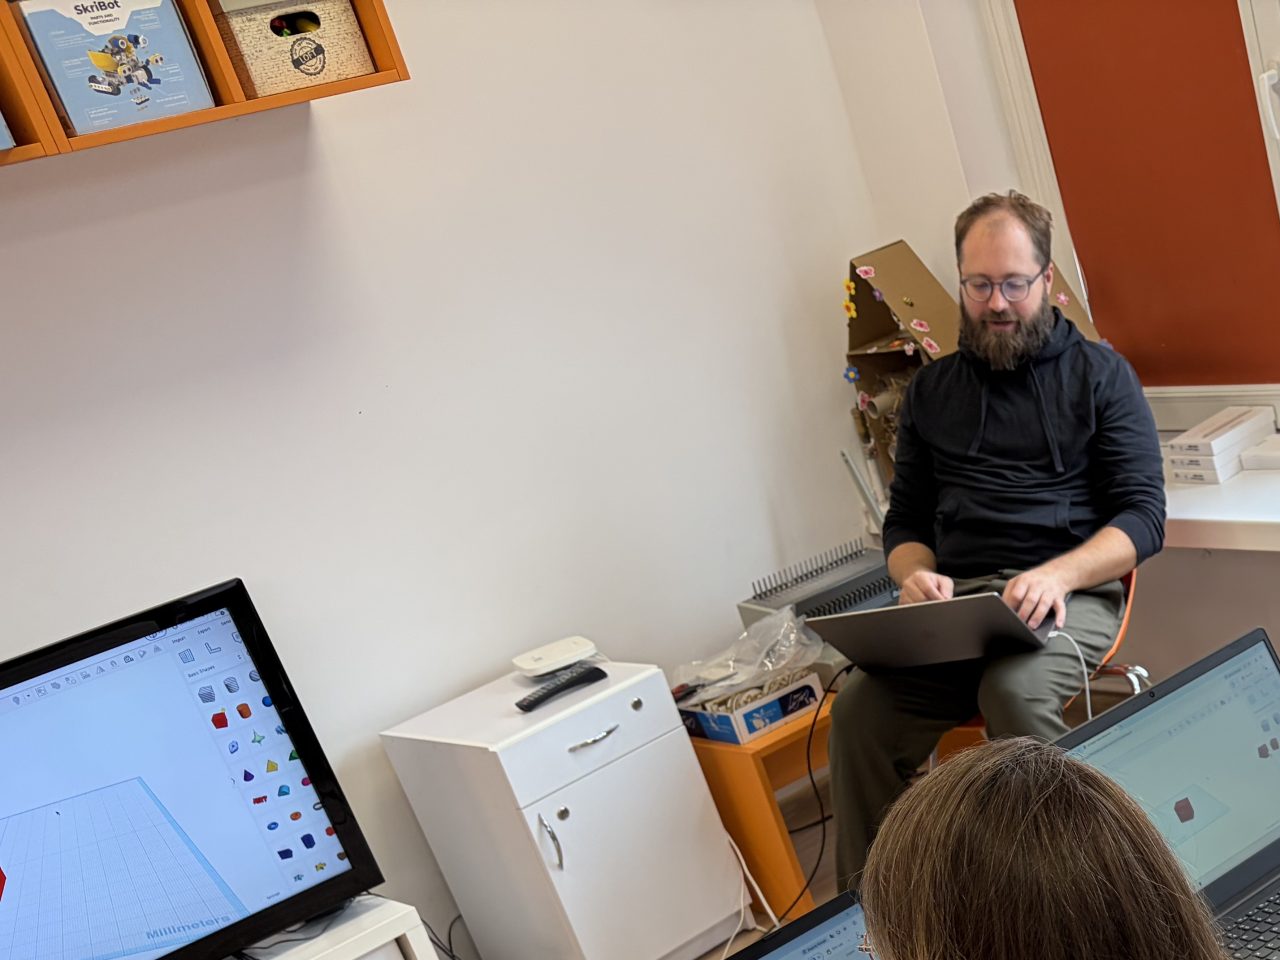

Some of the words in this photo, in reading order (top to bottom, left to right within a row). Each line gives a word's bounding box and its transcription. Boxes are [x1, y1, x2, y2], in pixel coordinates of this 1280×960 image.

[74, 0, 120, 15] SkriBot
[299, 49, 318, 65] LOFT
[145, 913, 231, 942] Millimeters
